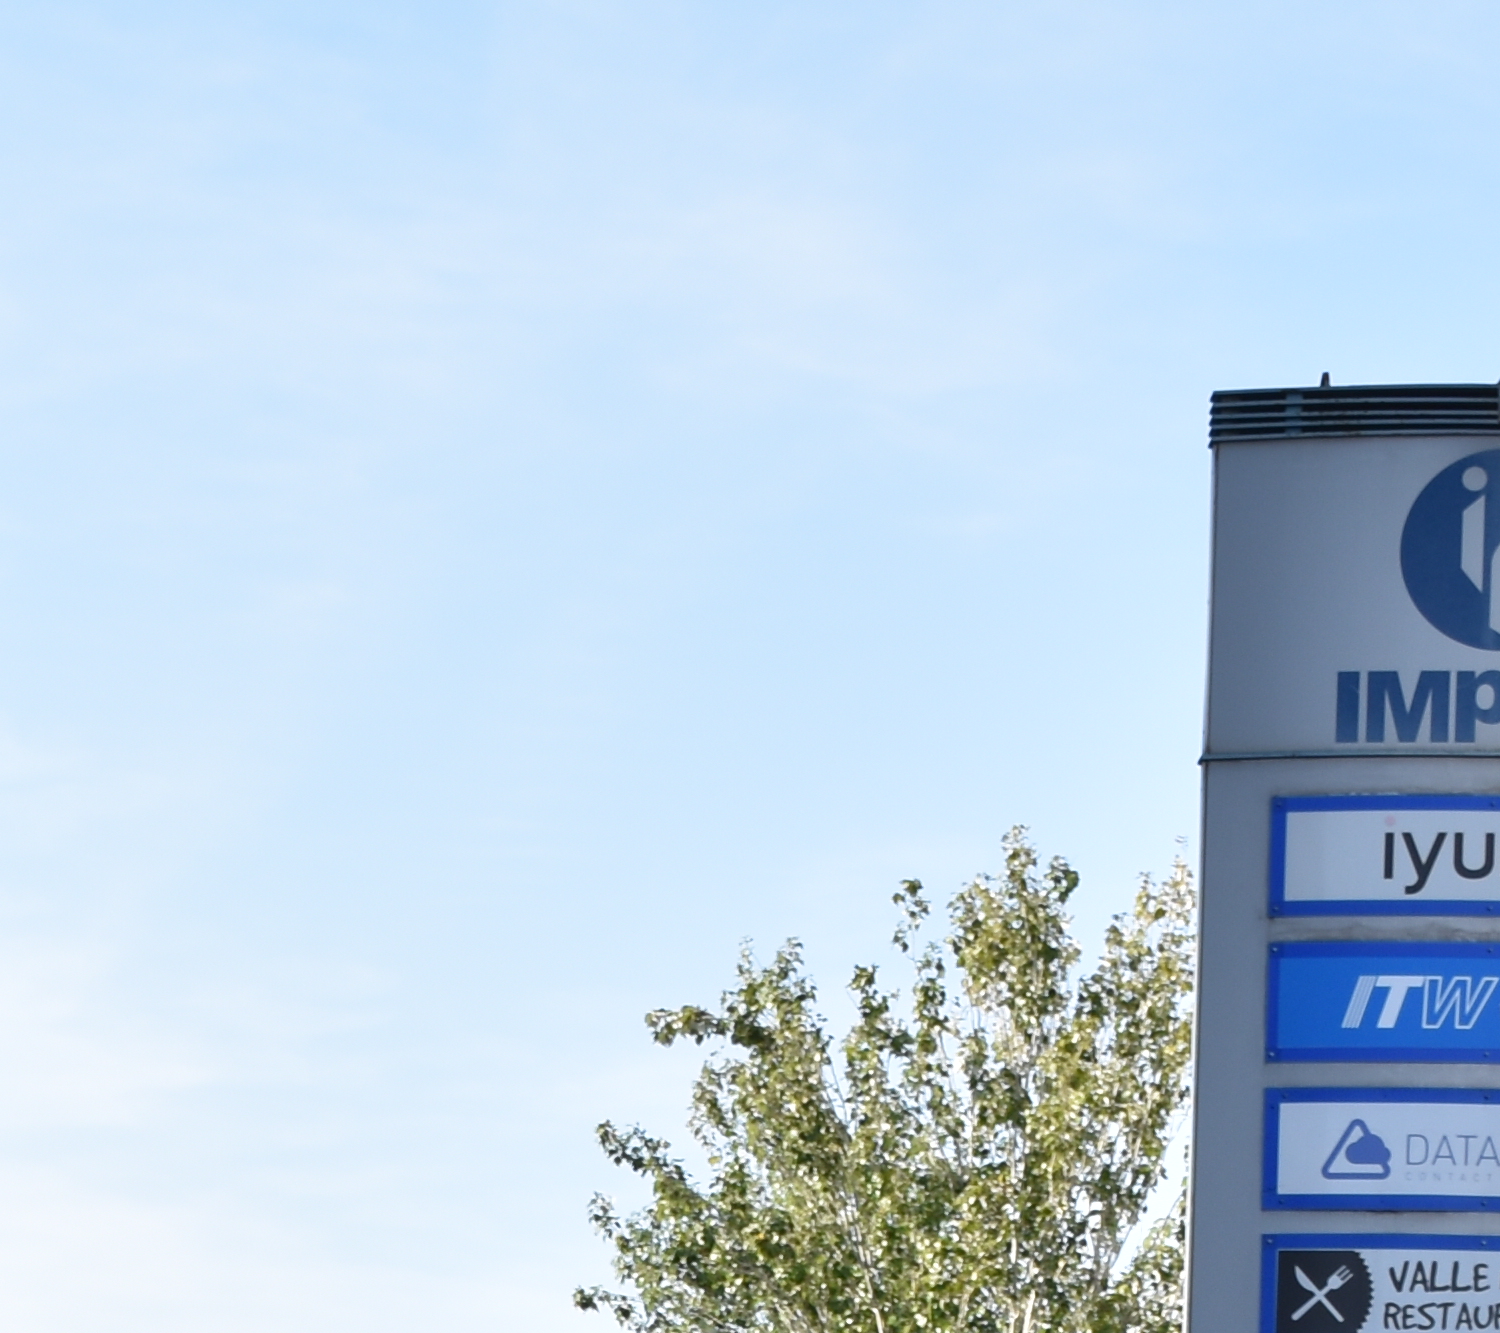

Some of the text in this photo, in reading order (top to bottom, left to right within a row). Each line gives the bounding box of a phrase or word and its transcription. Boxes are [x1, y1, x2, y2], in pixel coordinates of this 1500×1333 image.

[1341, 975, 1499, 1031] ITW
[1404, 1171, 1493, 1183] CONTACT
[1388, 1260, 1491, 1293] VALLE
